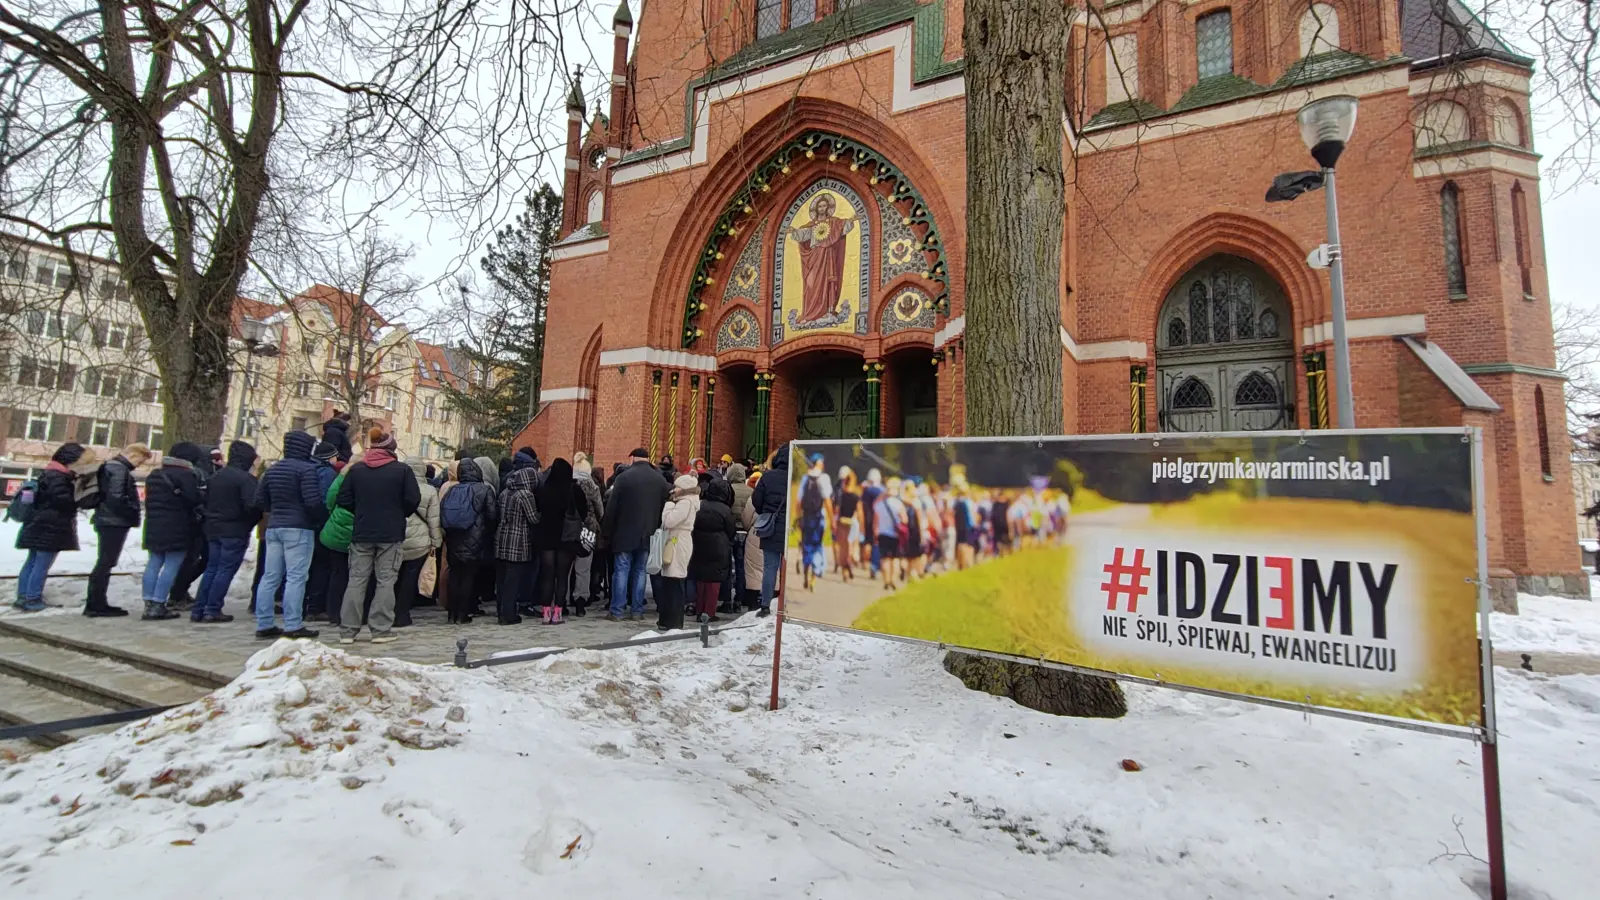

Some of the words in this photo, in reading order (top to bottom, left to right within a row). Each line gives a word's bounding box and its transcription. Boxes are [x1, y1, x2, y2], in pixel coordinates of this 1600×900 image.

[1152, 456, 1391, 486] pielgrzymkawarminska.pl
[1103, 615, 1128, 638] NIE
[1136, 614, 1173, 647] ŚPIJ,
[1177, 619, 1256, 659] ŚPIEWAJ,
[1262, 634, 1397, 673] EWANGELIZUJ
